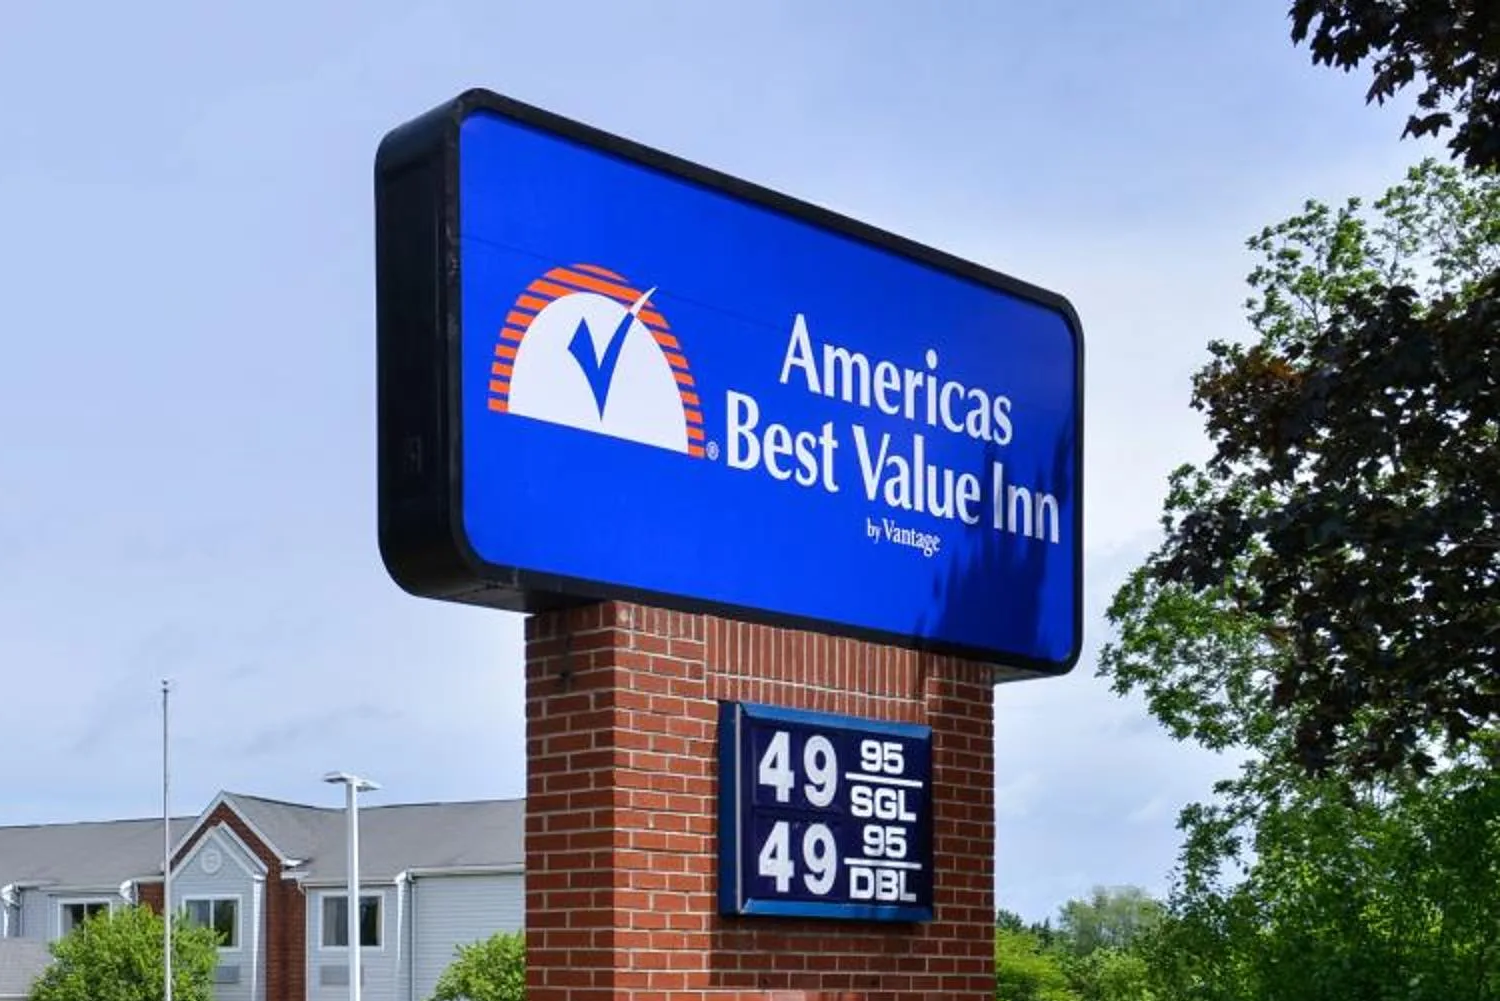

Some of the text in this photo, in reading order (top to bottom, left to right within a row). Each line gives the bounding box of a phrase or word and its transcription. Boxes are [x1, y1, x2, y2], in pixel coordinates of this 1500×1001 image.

[779, 312, 1014, 446] Americas
[726, 389, 1060, 544] Best Value Inn
[866, 517, 941, 558] by Vantage
[758, 731, 905, 808] 49 95
[850, 785, 917, 822] SGL
[758, 820, 908, 895] 49 95
[849, 867, 918, 902] DBL
